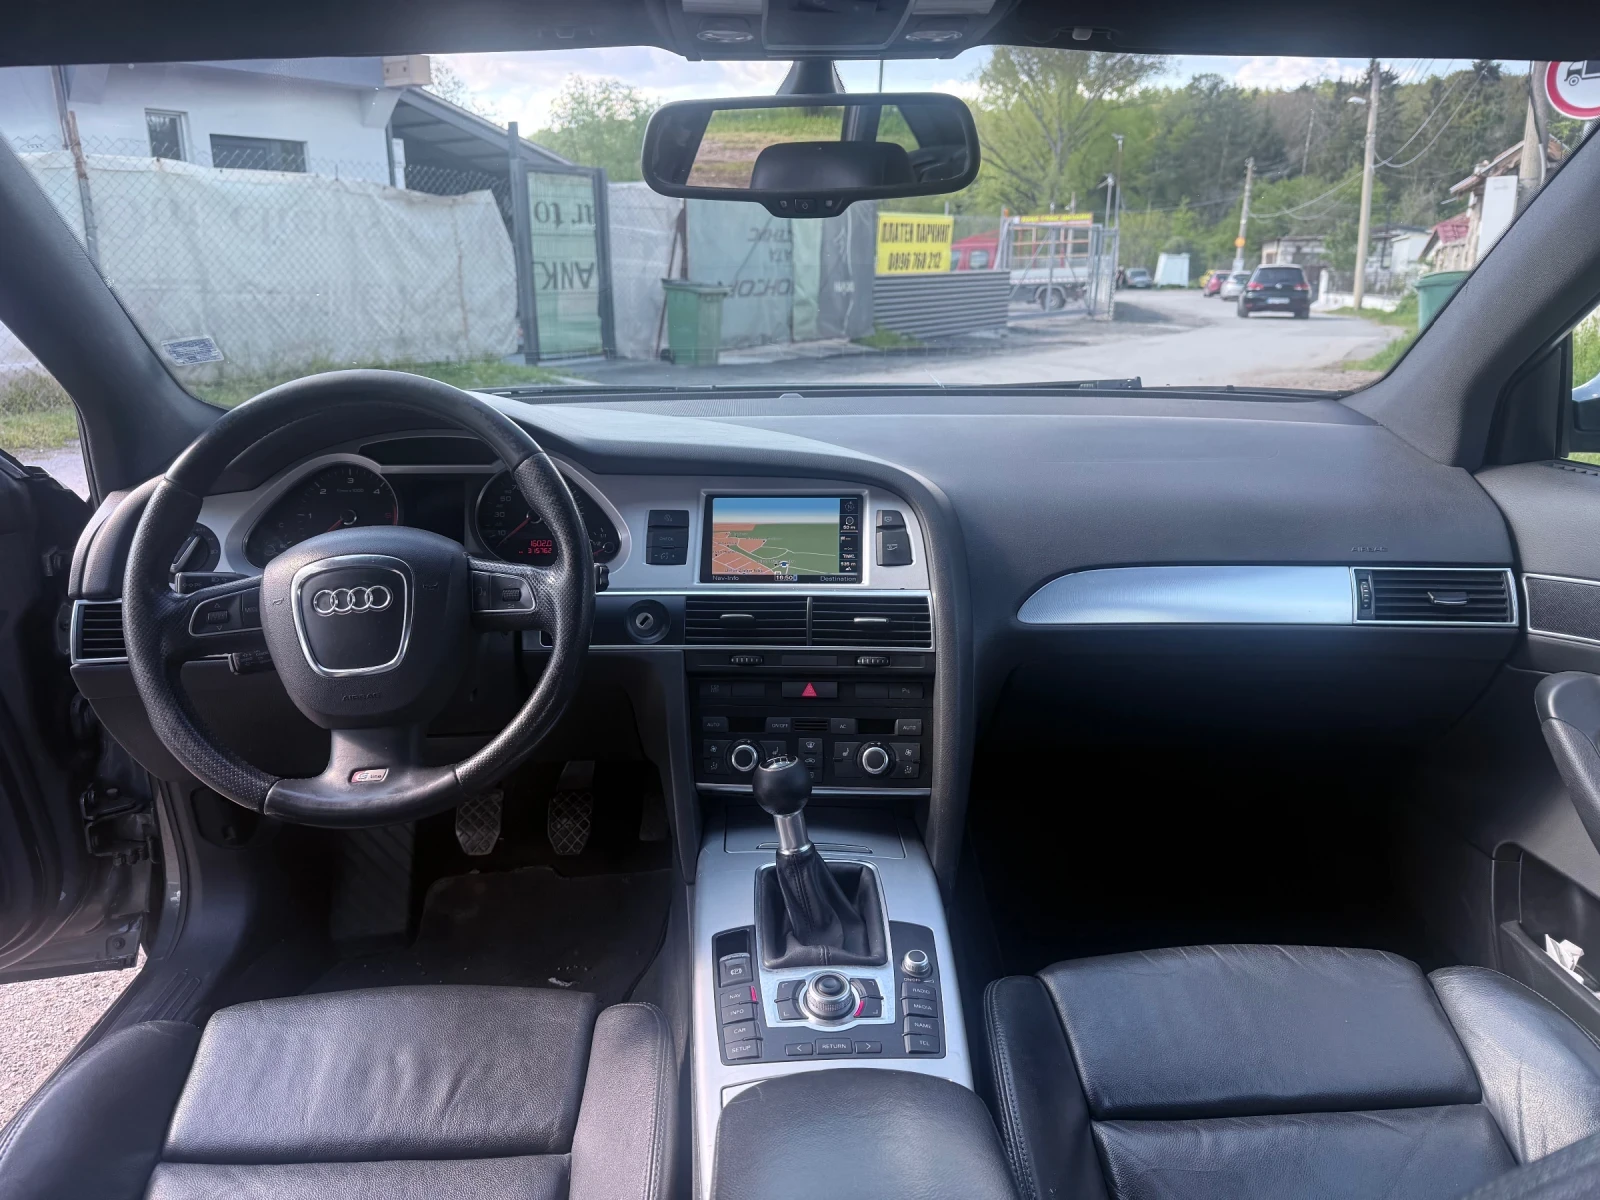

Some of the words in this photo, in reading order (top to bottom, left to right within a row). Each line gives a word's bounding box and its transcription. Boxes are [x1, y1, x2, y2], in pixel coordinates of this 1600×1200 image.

[881, 222, 914, 243] ПЛАТЕН
[916, 223, 950, 243] ПАРКИНГ
[887, 252, 911, 271] 0896
[820, 574, 857, 582] Destination
[913, 1003, 932, 1011] MEDIA
[731, 1045, 751, 1053] SETUP
